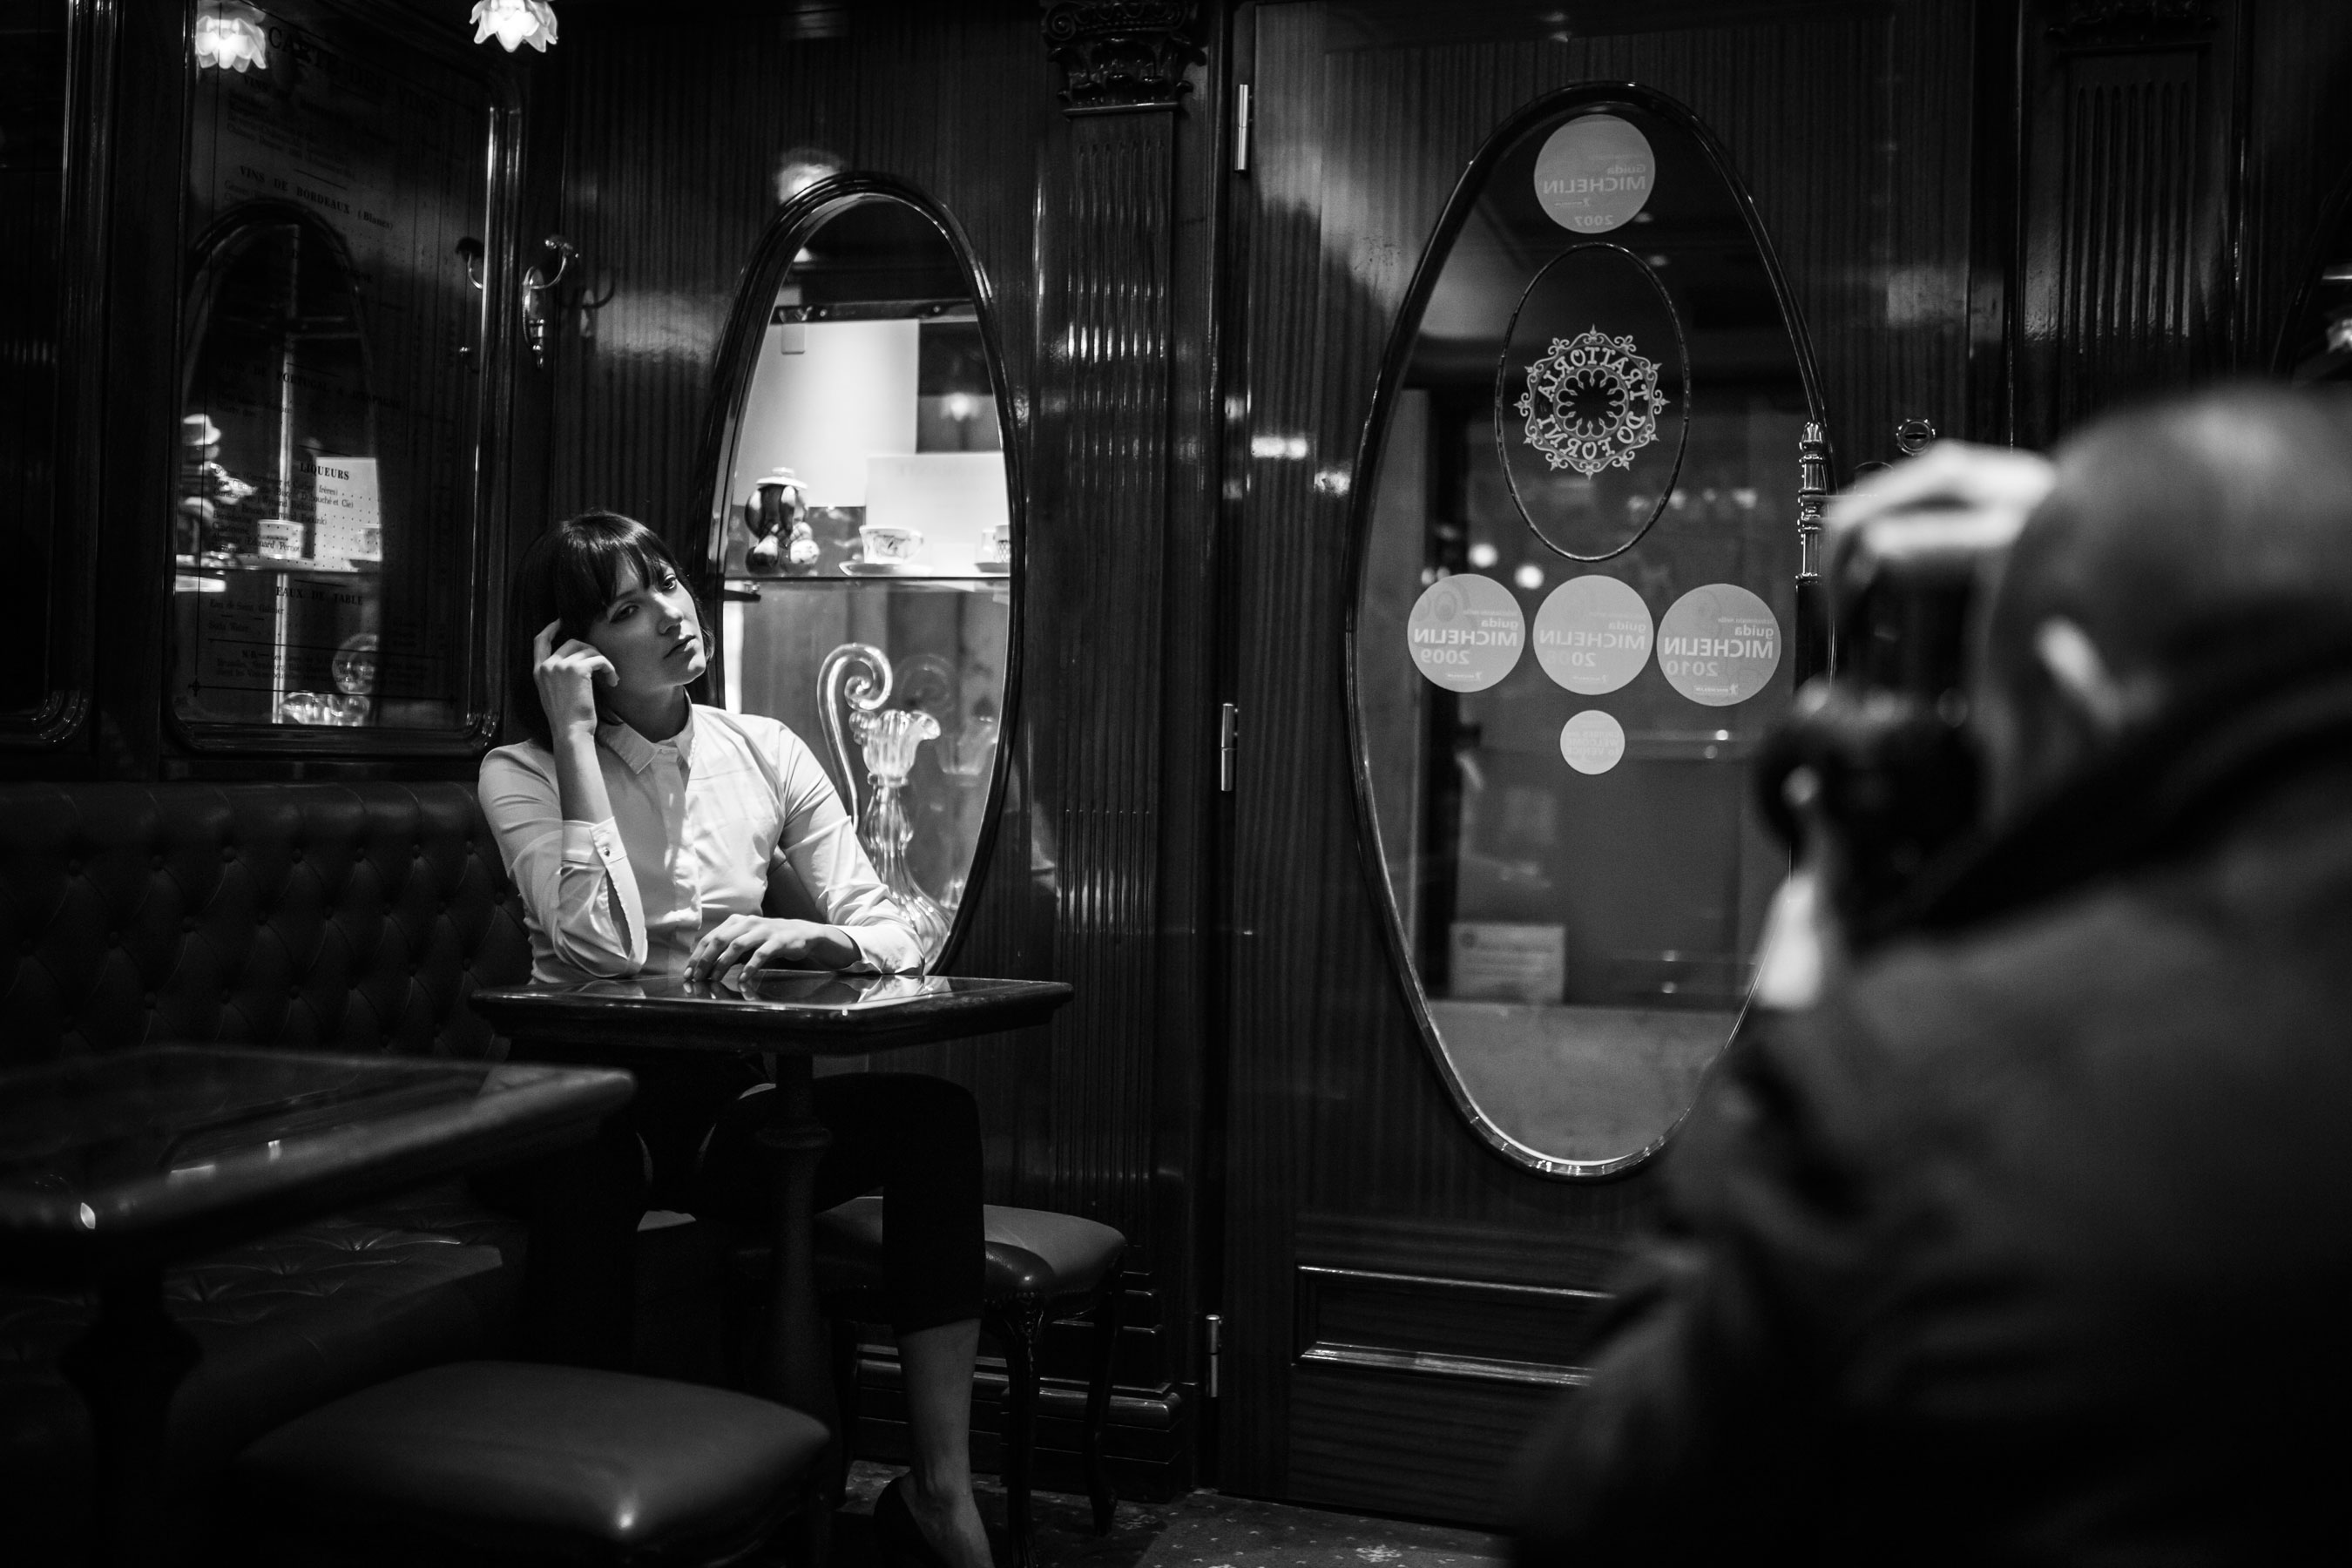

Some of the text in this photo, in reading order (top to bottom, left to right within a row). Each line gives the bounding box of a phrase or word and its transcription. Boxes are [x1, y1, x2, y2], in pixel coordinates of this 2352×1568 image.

[397, 84, 440, 119] VINS
[240, 165, 265, 184] VINS
[273, 177, 288, 192] DE
[296, 186, 351, 214] BORDEAUX
[300, 463, 349, 481] LIQUEURS
[275, 586, 363, 605] EAUX DE TABLE
